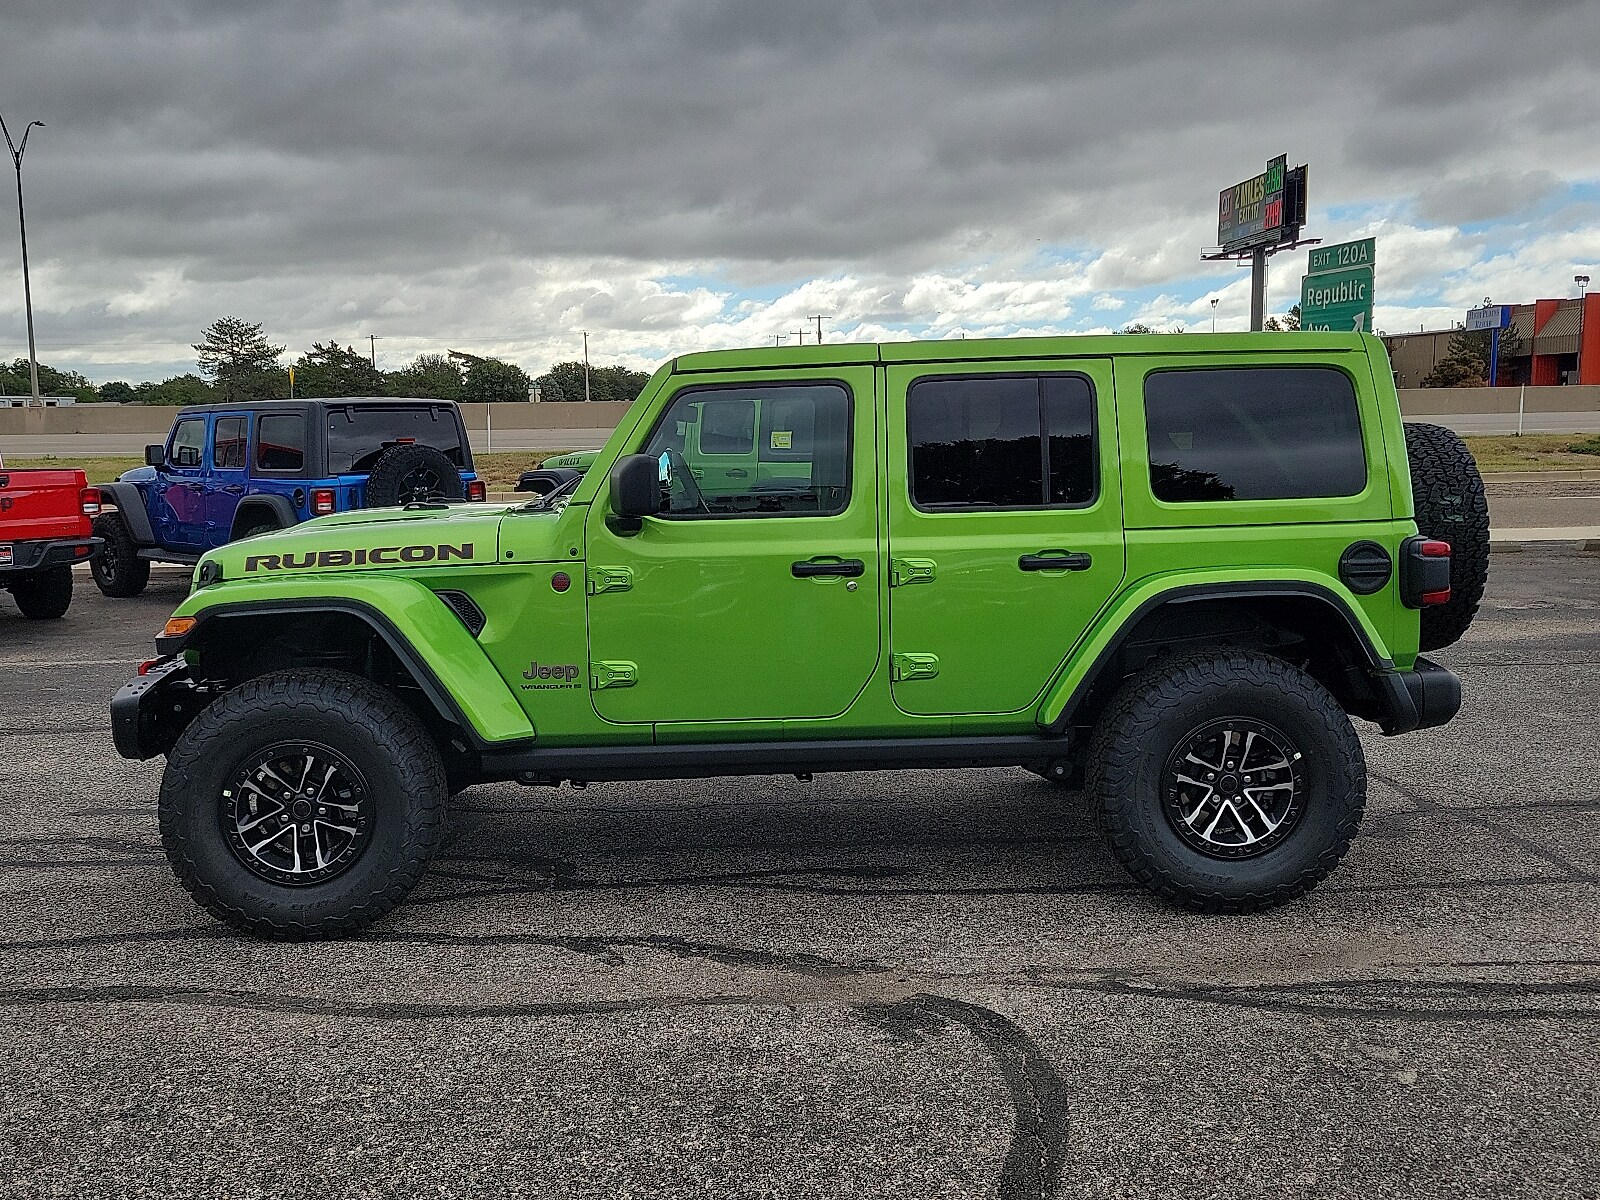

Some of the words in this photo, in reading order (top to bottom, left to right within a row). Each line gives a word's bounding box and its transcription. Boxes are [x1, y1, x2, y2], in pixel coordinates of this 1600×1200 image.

[1221, 193, 1232, 216] QT
[1235, 186, 1241, 209] 2
[1241, 176, 1264, 206] MILES
[1238, 206, 1251, 225] EXIT
[1313, 252, 1331, 267] EXIT
[1337, 243, 1368, 265] 120A
[1306, 279, 1366, 309] Republic
[245, 542, 474, 572] RUBICON
[522, 661, 580, 682] Jeep
